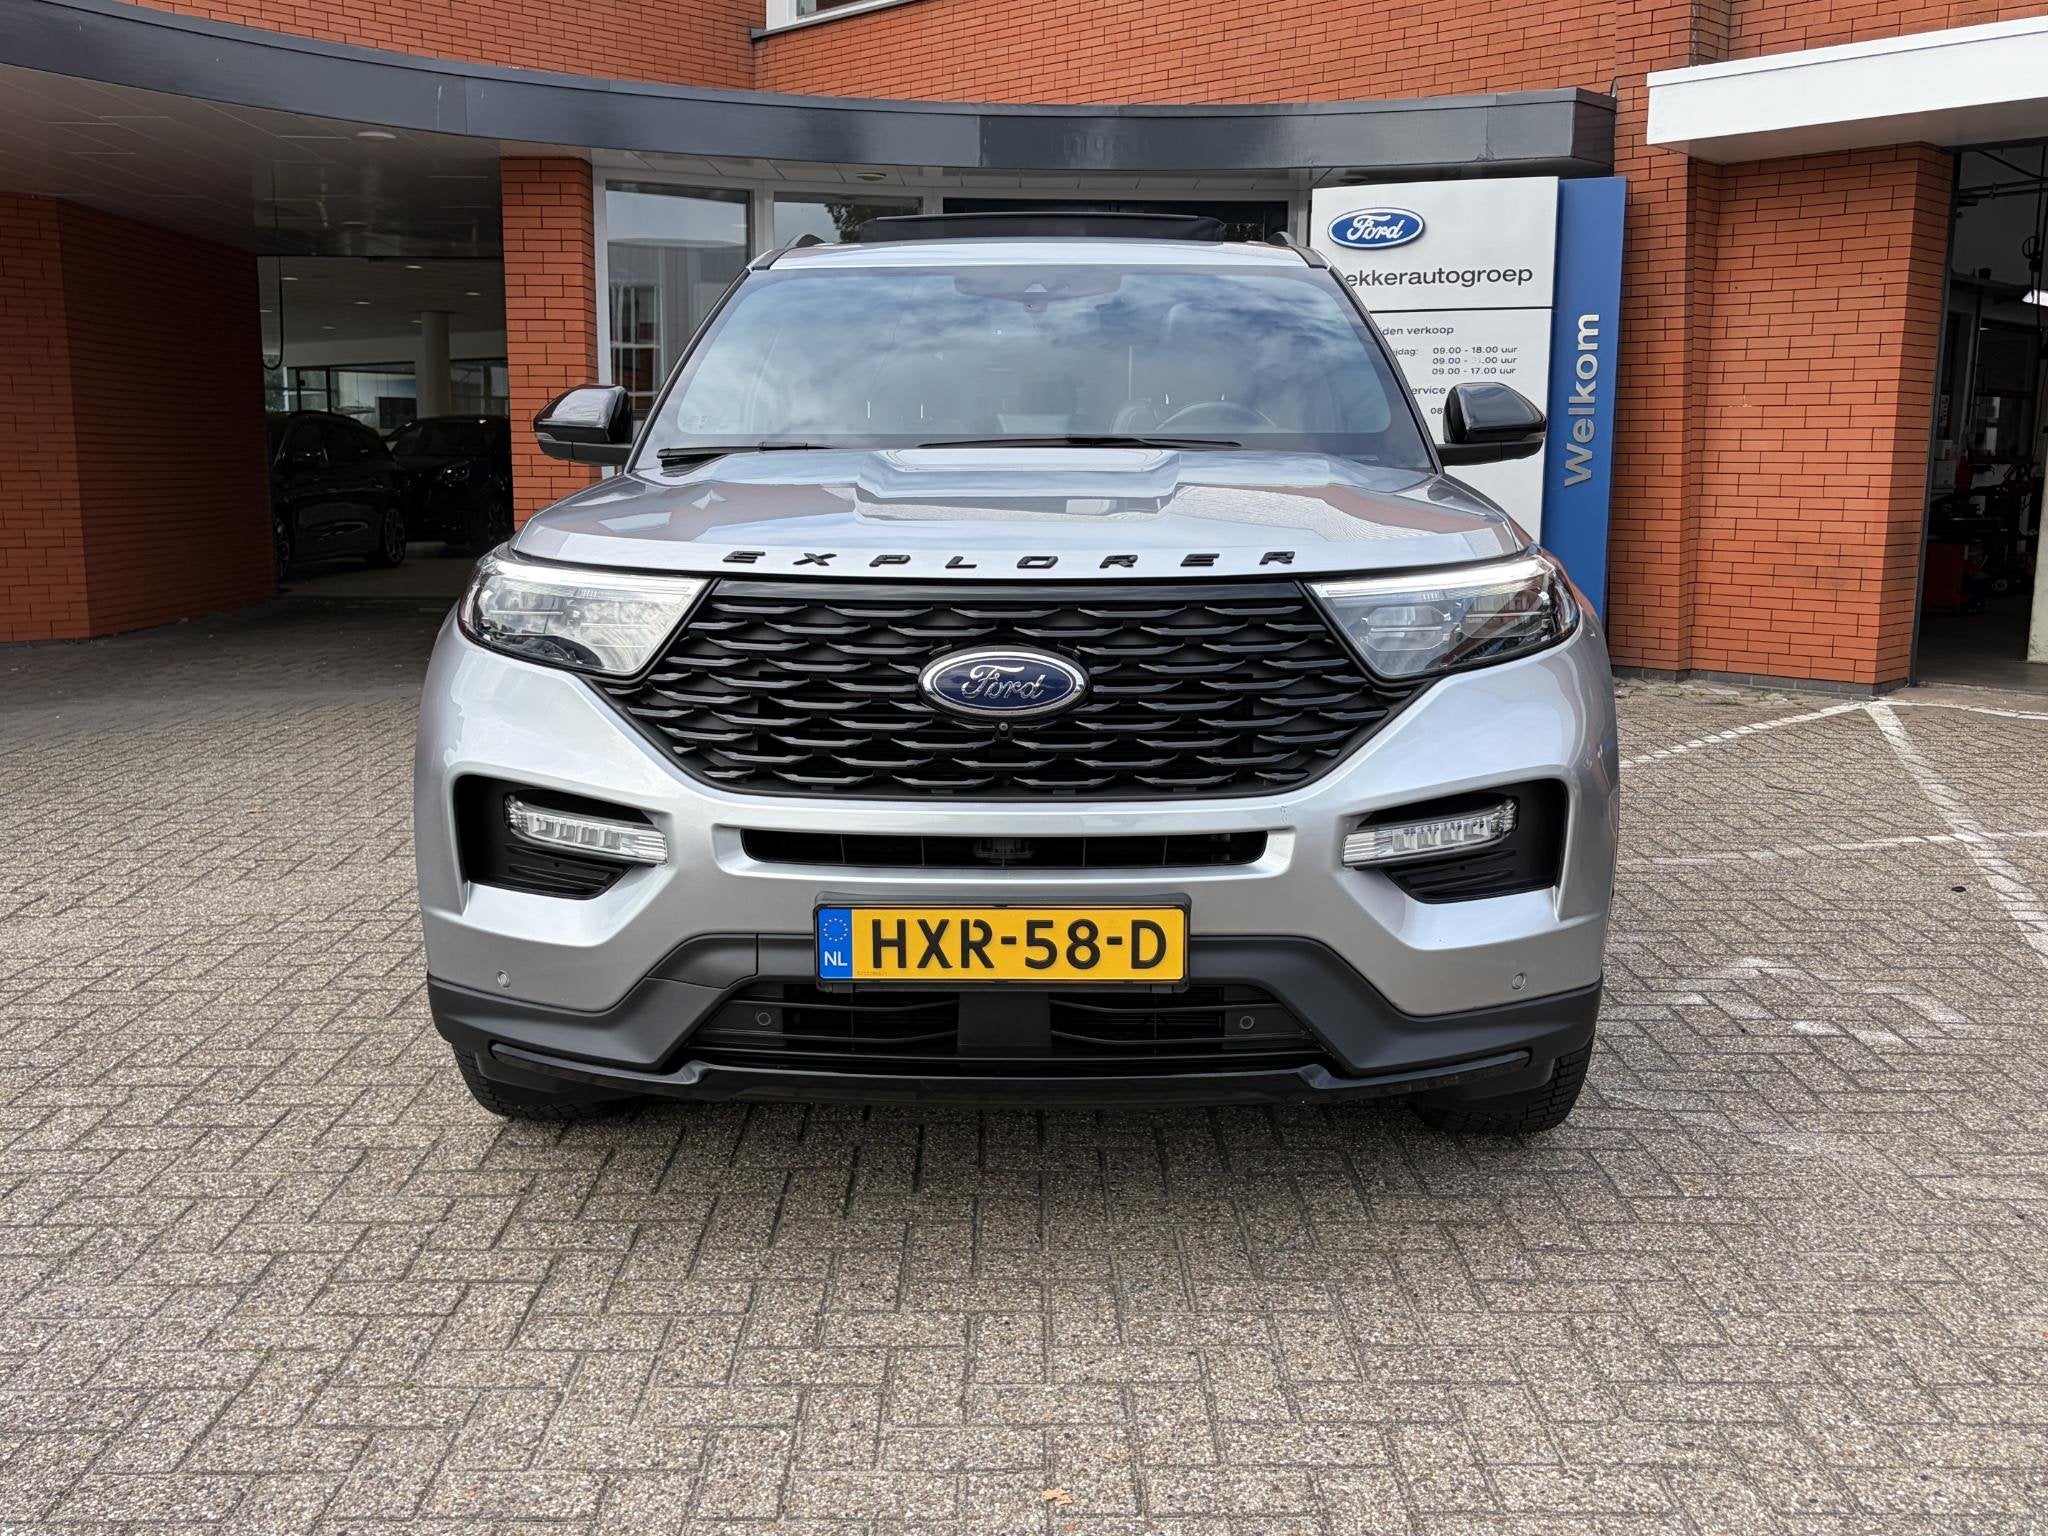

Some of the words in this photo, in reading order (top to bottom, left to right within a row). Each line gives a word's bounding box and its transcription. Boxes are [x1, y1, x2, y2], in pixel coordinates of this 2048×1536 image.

[1346, 214, 1406, 241] Ford
[1345, 267, 1534, 288] ekkerautogroep
[1380, 326, 1404, 336] den
[1407, 326, 1454, 336] verkoop
[1432, 346, 1461, 354] 09.00
[1471, 346, 1499, 354] 18.00
[1432, 357, 1461, 365] 09.00
[1431, 367, 1460, 375] 09.00
[1471, 367, 1497, 375] 17.00
[1411, 386, 1447, 395] ervice
[1564, 313, 1600, 487] Welkom
[1430, 407, 1445, 415] 08
[722, 549, 1296, 570] EXPLORER
[961, 664, 1047, 699] Ford
[824, 950, 848, 967] NL
[871, 918, 1167, 970] HXR-58-D
